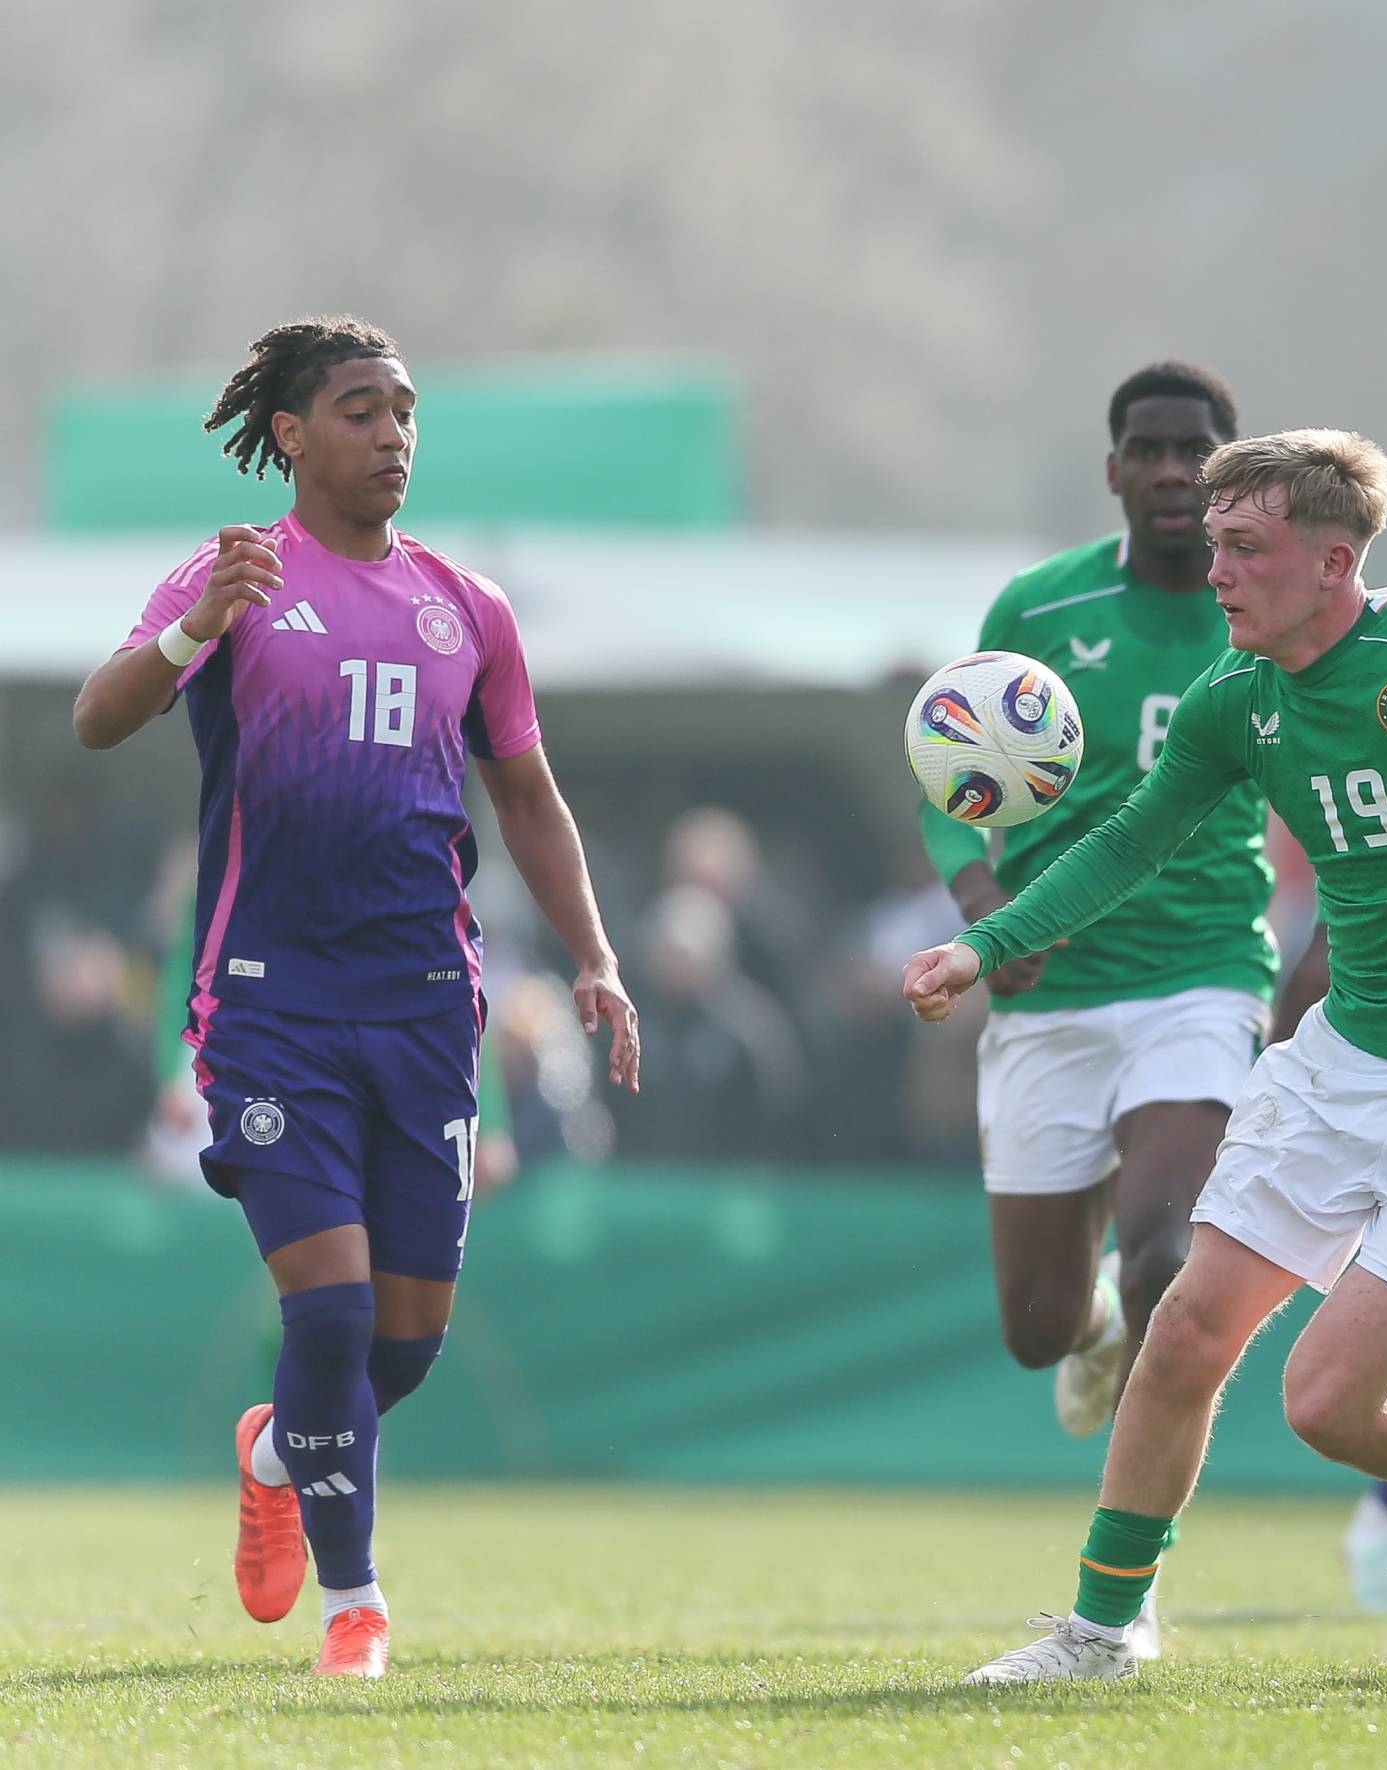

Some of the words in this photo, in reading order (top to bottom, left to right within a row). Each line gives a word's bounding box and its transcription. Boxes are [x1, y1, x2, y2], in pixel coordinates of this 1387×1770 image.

[340, 659, 416, 747] 18
[444, 1115, 480, 1201] 1
[286, 1430, 356, 1450] DFB
